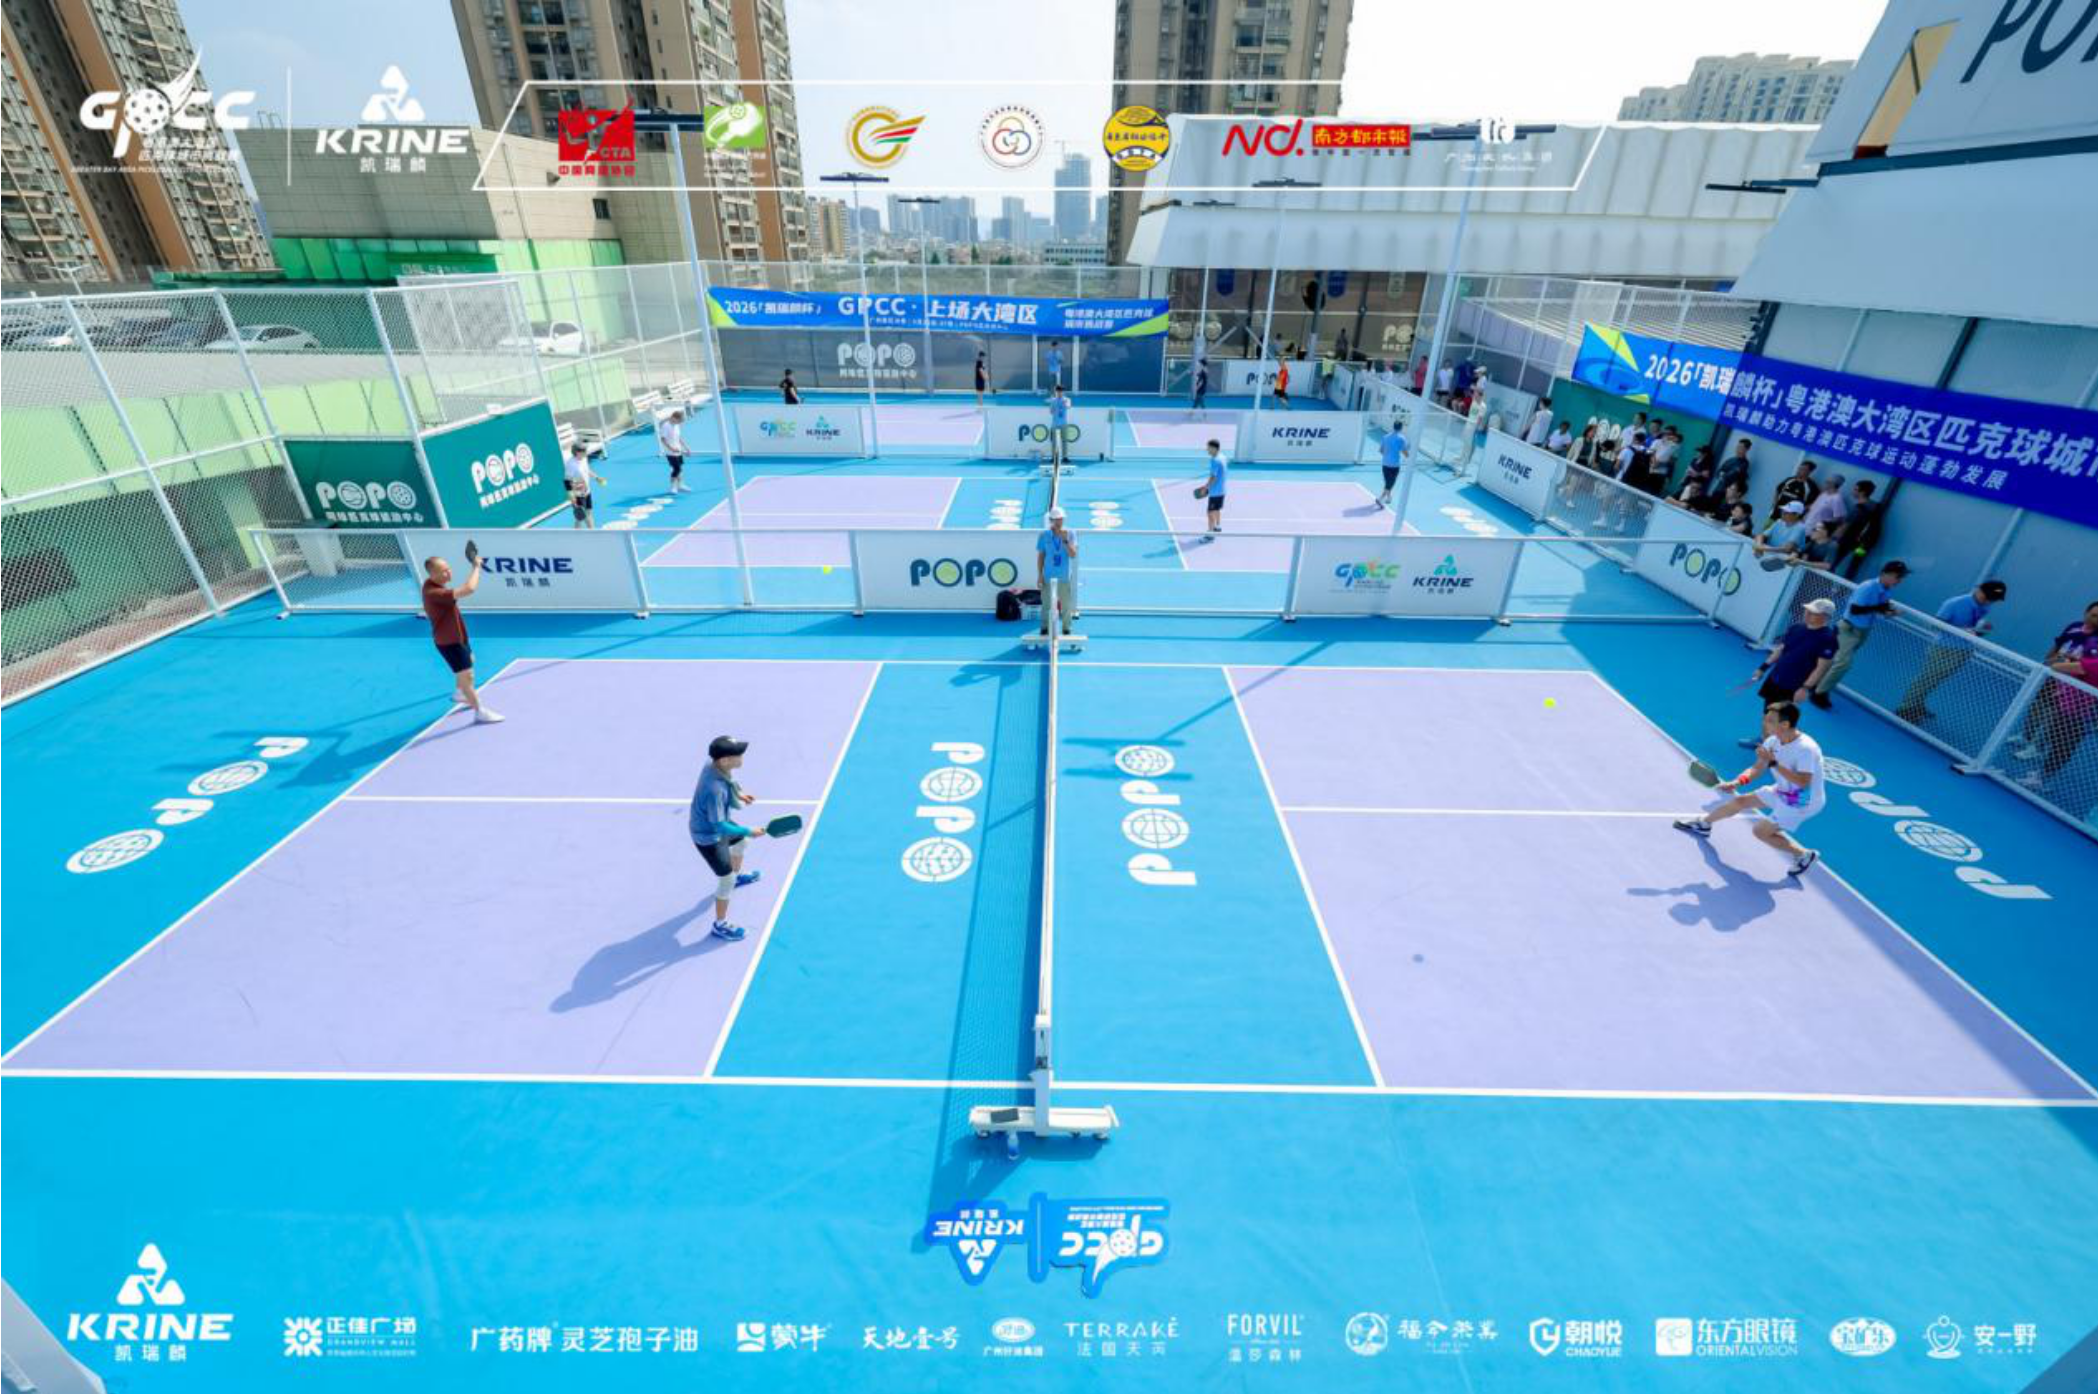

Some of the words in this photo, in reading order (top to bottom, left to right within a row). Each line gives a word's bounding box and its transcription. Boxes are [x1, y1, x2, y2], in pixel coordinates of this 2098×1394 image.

[1959, 0, 2098, 83] PO
[838, 297, 906, 315] GPCC
[928, 300, 1038, 325] 上场大湾区
[837, 342, 916, 367] POPO
[1272, 426, 1332, 439] KRINE
[471, 442, 534, 494] POPO
[1497, 453, 1532, 480] KRINE
[315, 481, 417, 509] POPO
[910, 557, 1018, 587] POPO
[1335, 562, 1400, 588] GPCC
[1413, 577, 1474, 588] KRINE
[1669, 543, 1741, 597] POPO
[66, 736, 309, 874] POPO
[901, 742, 986, 883] POPO
[1115, 745, 1198, 886] POPO
[933, 1219, 1024, 1236] KRINE
[1058, 1214, 1164, 1257] GPCC
